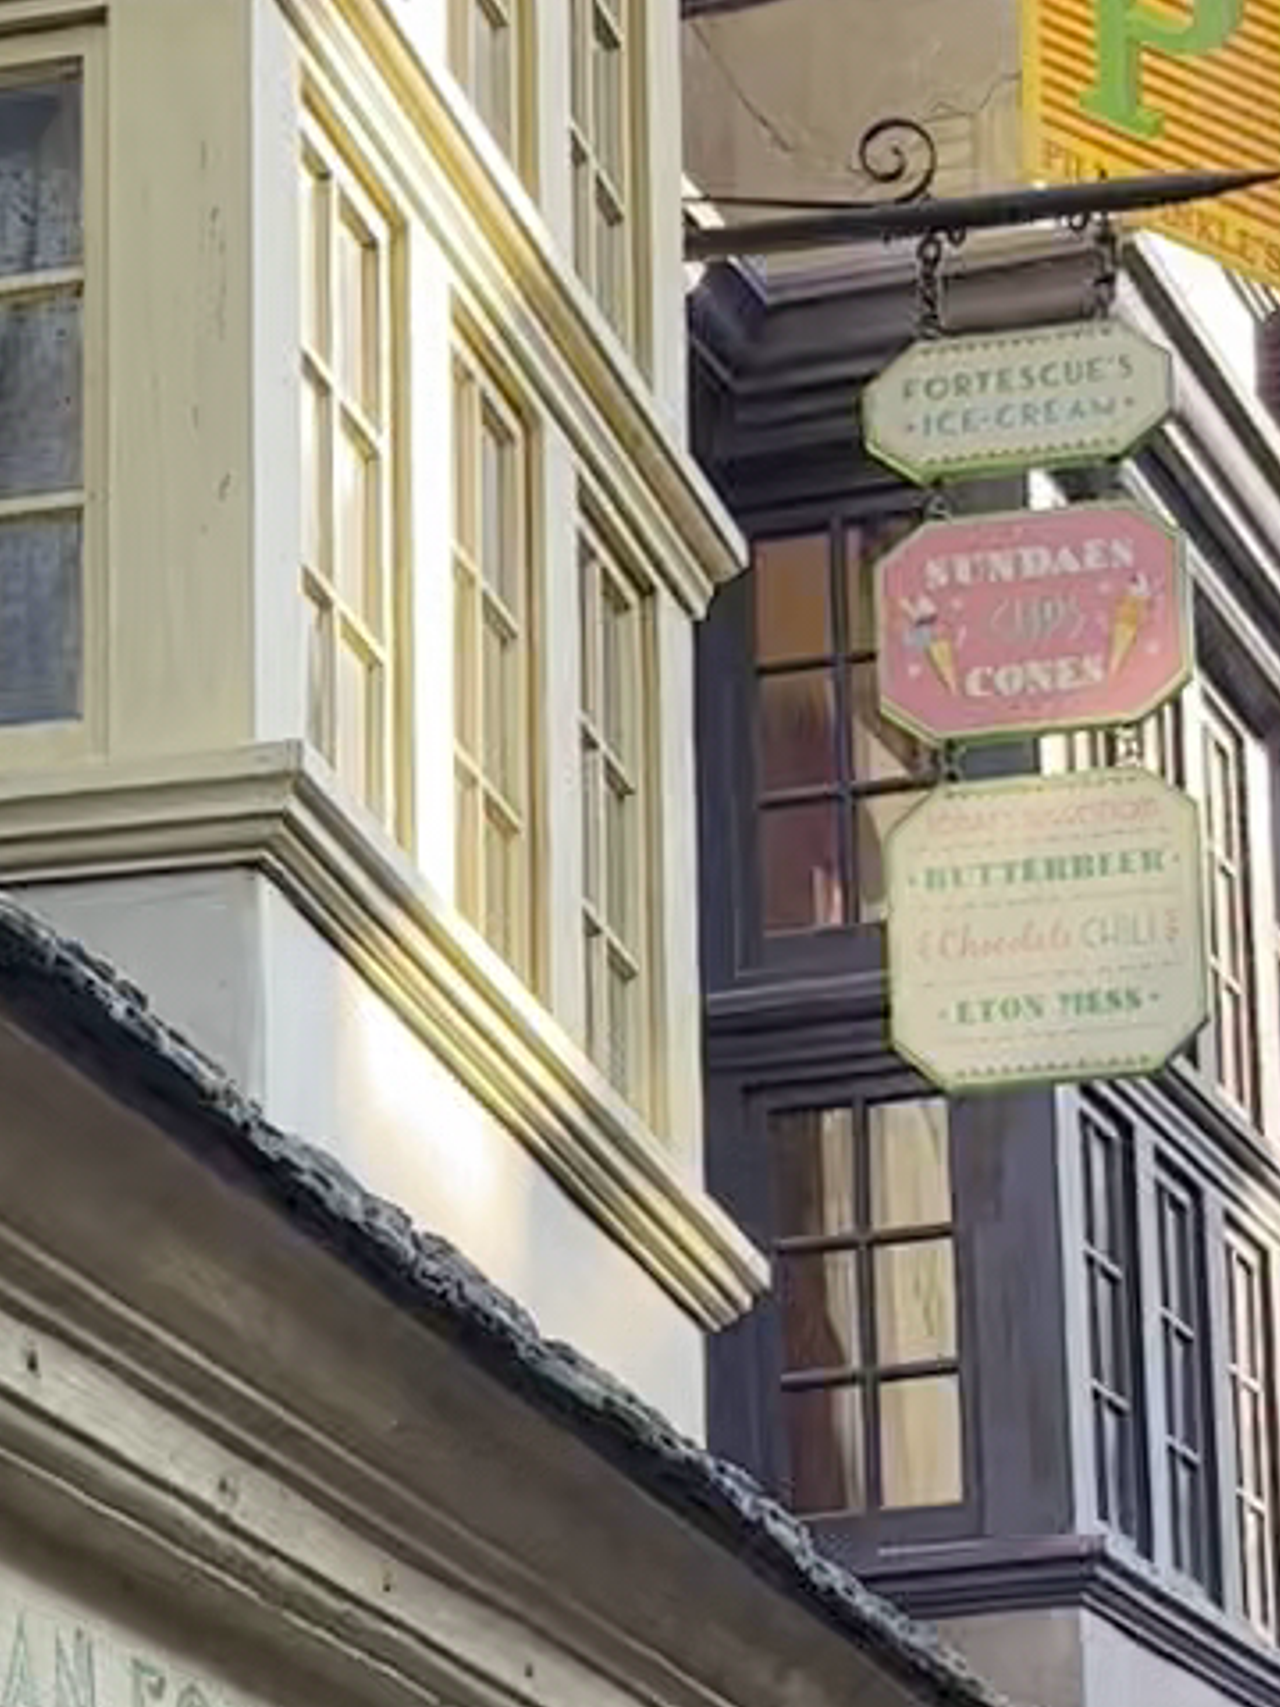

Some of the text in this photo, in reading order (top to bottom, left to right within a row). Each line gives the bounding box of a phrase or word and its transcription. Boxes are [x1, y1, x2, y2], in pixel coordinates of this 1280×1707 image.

[900, 353, 1134, 403] FORTESCUE'S
[919, 396, 1117, 439] ICE-CREAM
[924, 537, 1135, 590] SUNDAES
[964, 655, 1106, 698] CONES
[923, 848, 1164, 892] BUTTERBEER
[955, 986, 1144, 1026] ETON MESS
